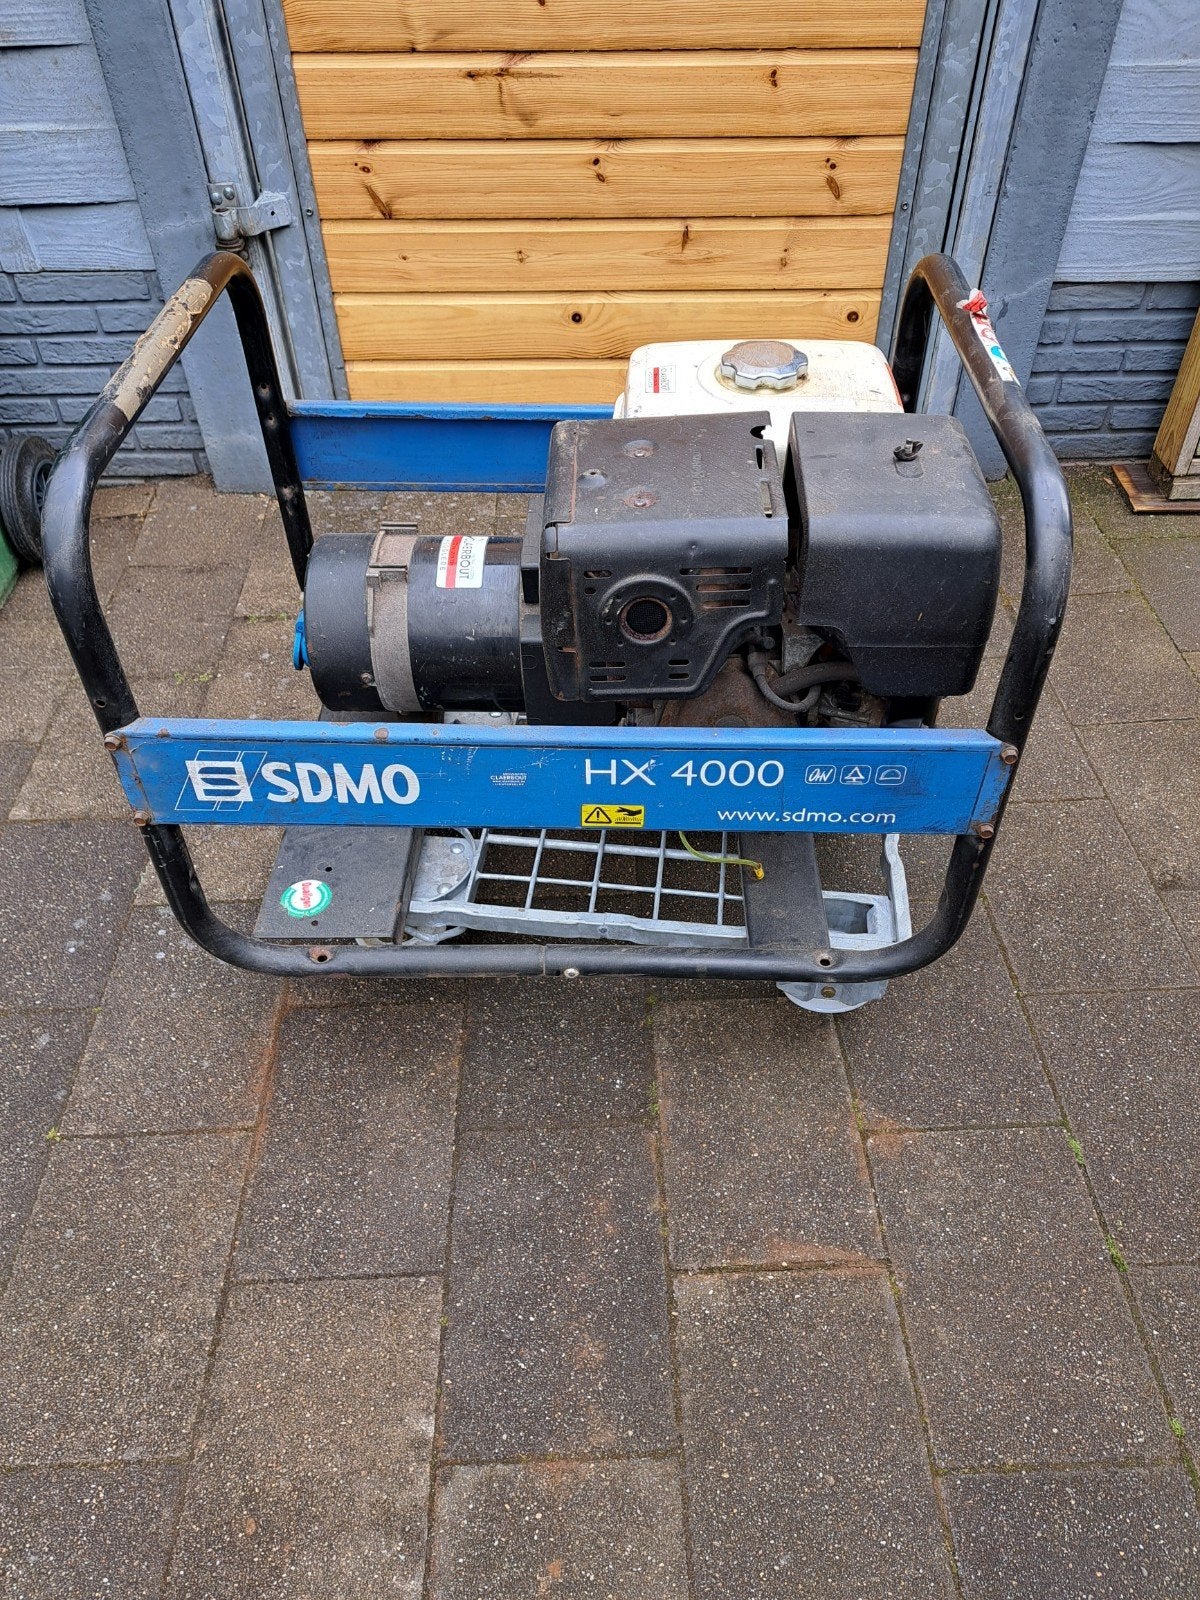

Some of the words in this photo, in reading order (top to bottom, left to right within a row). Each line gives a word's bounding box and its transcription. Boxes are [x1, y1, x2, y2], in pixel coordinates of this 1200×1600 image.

[261, 761, 420, 805] SDMO
[585, 758, 657, 786] HX
[670, 759, 785, 787] 4000
[717, 807, 897, 824] www.sdmo.com
